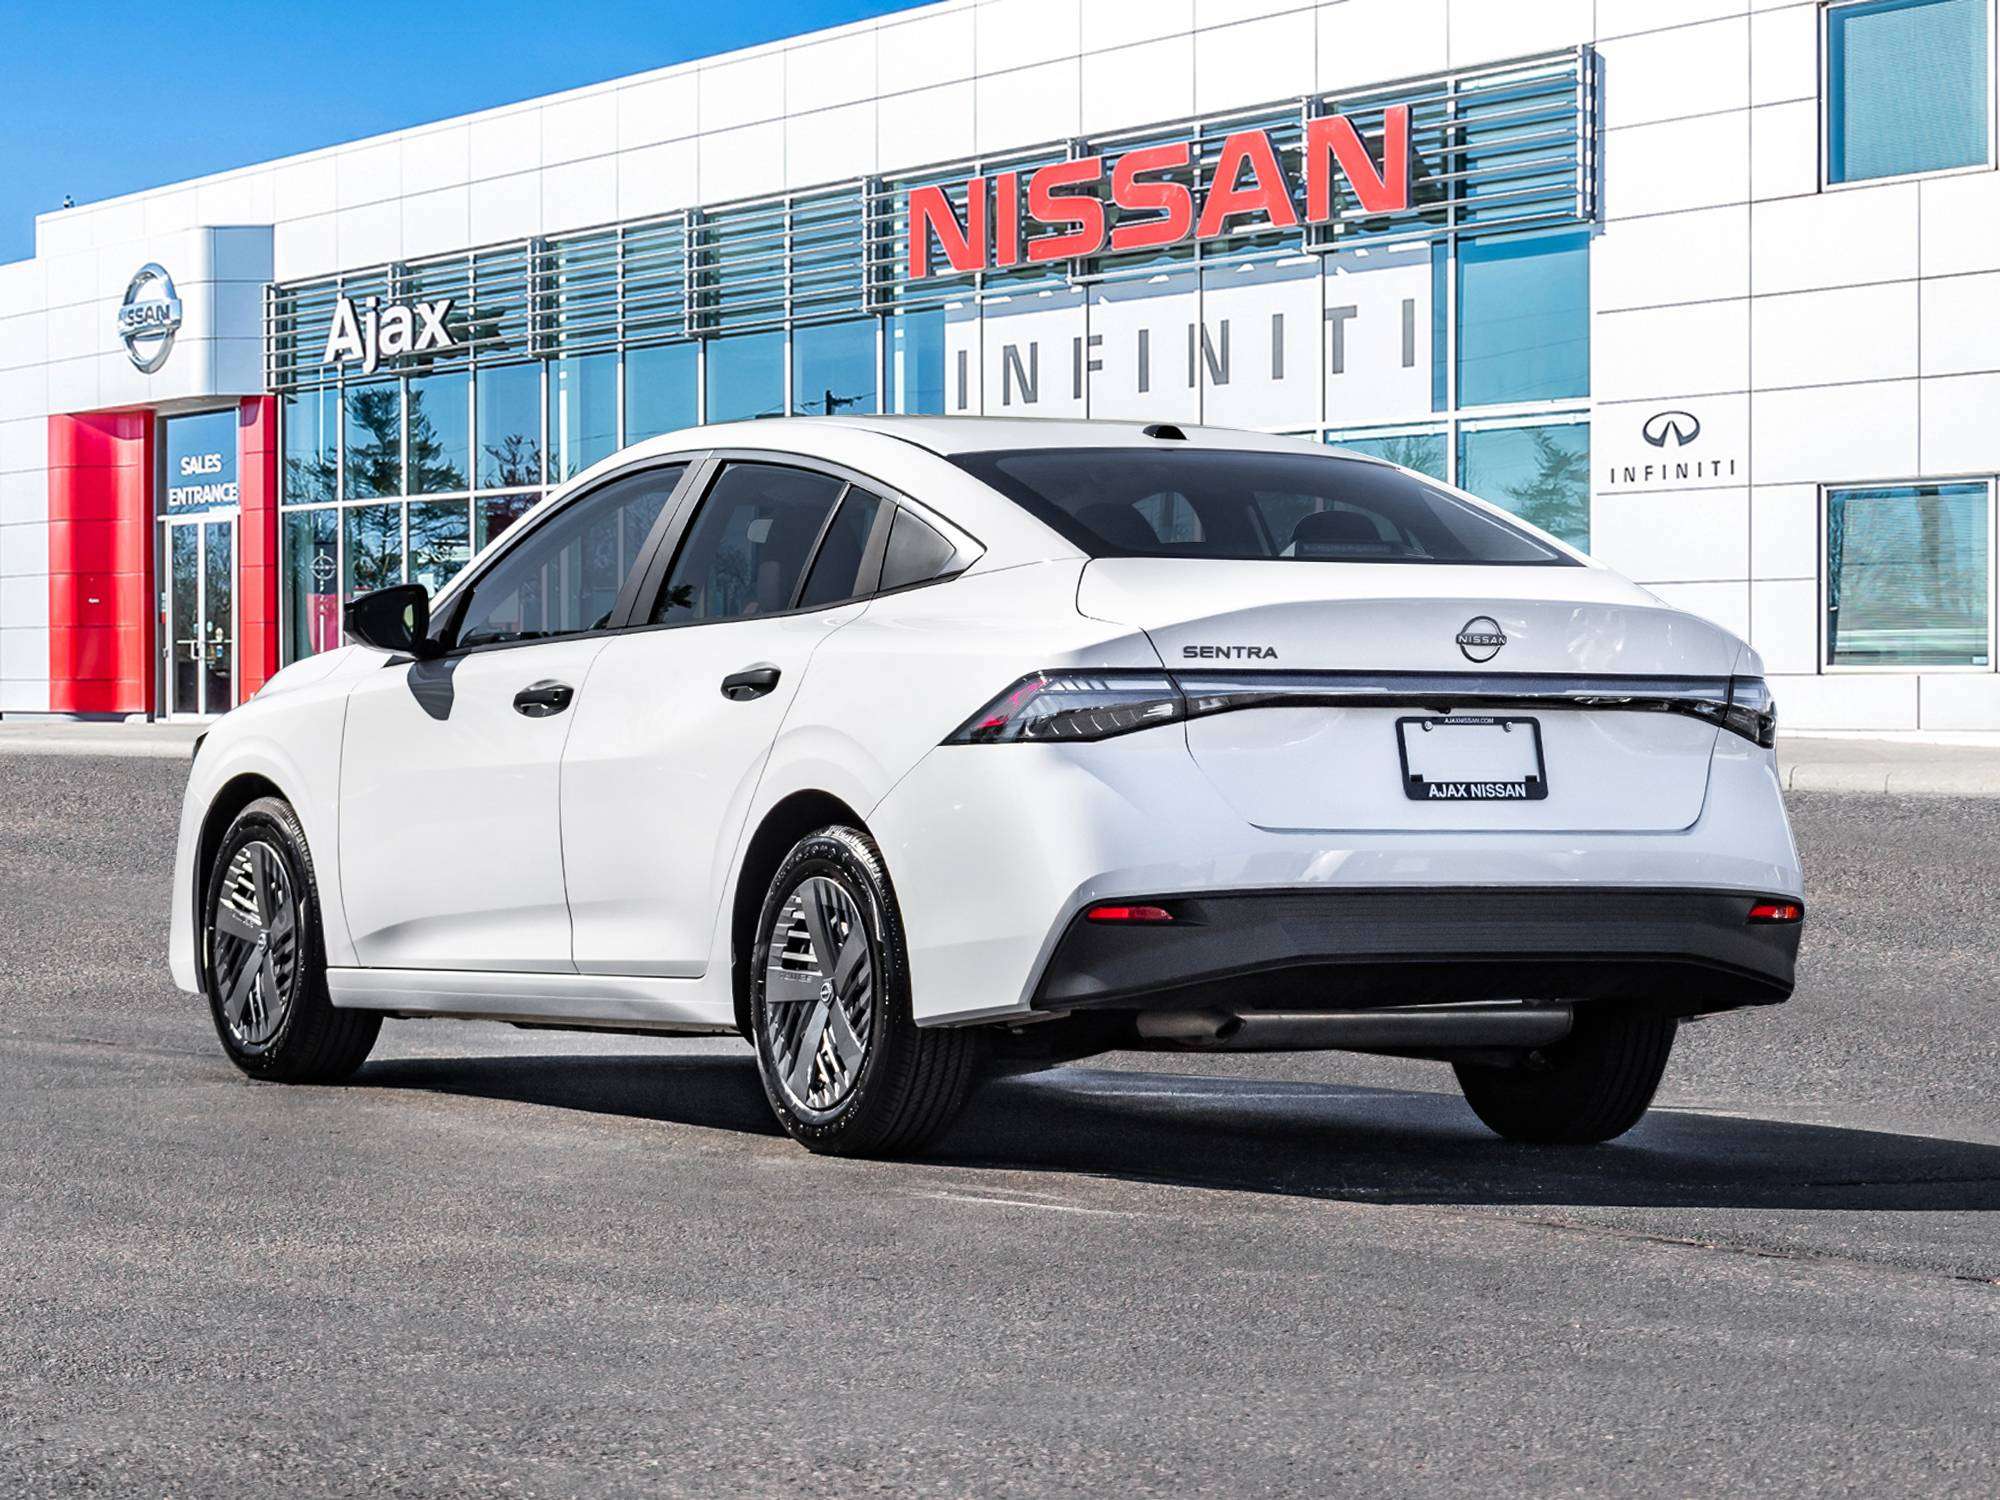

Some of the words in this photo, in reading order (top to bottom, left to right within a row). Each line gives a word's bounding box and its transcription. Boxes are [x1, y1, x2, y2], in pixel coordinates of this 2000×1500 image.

[908, 104, 1411, 280] NISSAN
[120, 304, 170, 327] SSAN
[323, 296, 454, 373] Ajax
[957, 298, 1415, 411] INFINITI
[180, 453, 222, 476] SALES
[1610, 459, 1735, 484] INFINITI
[168, 482, 238, 506] ENTRANCE
[1459, 634, 1506, 645] NISSAN
[1183, 645, 1278, 659] SENTRA
[1429, 784, 1467, 798] AJAX
[1471, 784, 1526, 798] NISSAN
